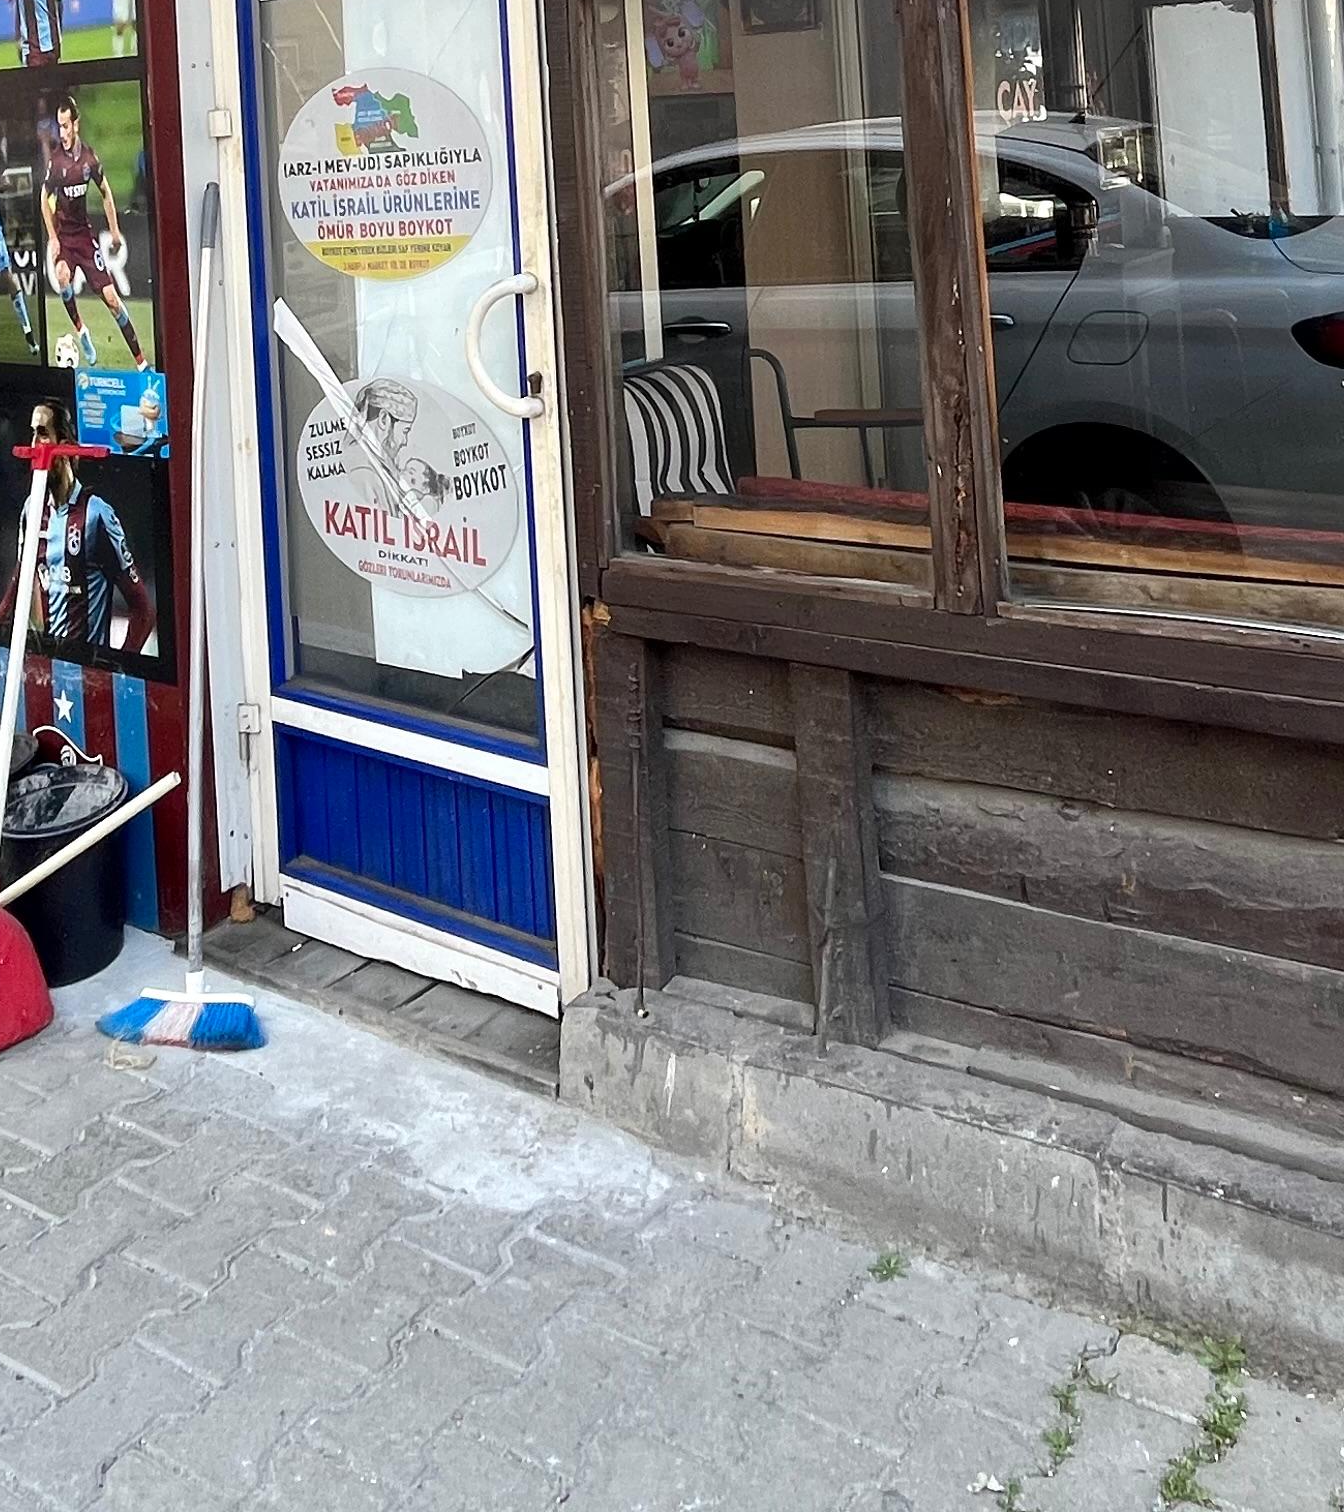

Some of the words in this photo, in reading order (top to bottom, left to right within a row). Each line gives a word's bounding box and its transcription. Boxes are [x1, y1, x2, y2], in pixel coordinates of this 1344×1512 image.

[384, 146, 482, 170] SAPIKLIĞIYLA
[309, 175, 375, 193] VATANIMIZA
[376, 174, 392, 188] DA
[395, 170, 417, 187] GÖZ
[419, 169, 456, 185] DİKEN
[290, 195, 331, 220] KATİL
[333, 191, 380, 216] İSRAİL
[383, 185, 481, 214] ÜRÜNLERİNE
[317, 220, 354, 240] ÖMÜR
[359, 220, 395, 238] BOYU
[398, 218, 453, 236] BOYKOT
[308, 417, 347, 438] ZULME
[453, 442, 489, 467] BOYKOT
[306, 462, 346, 481] KALMA
[453, 464, 506, 500] BOYKOT
[324, 499, 395, 547] KATİL
